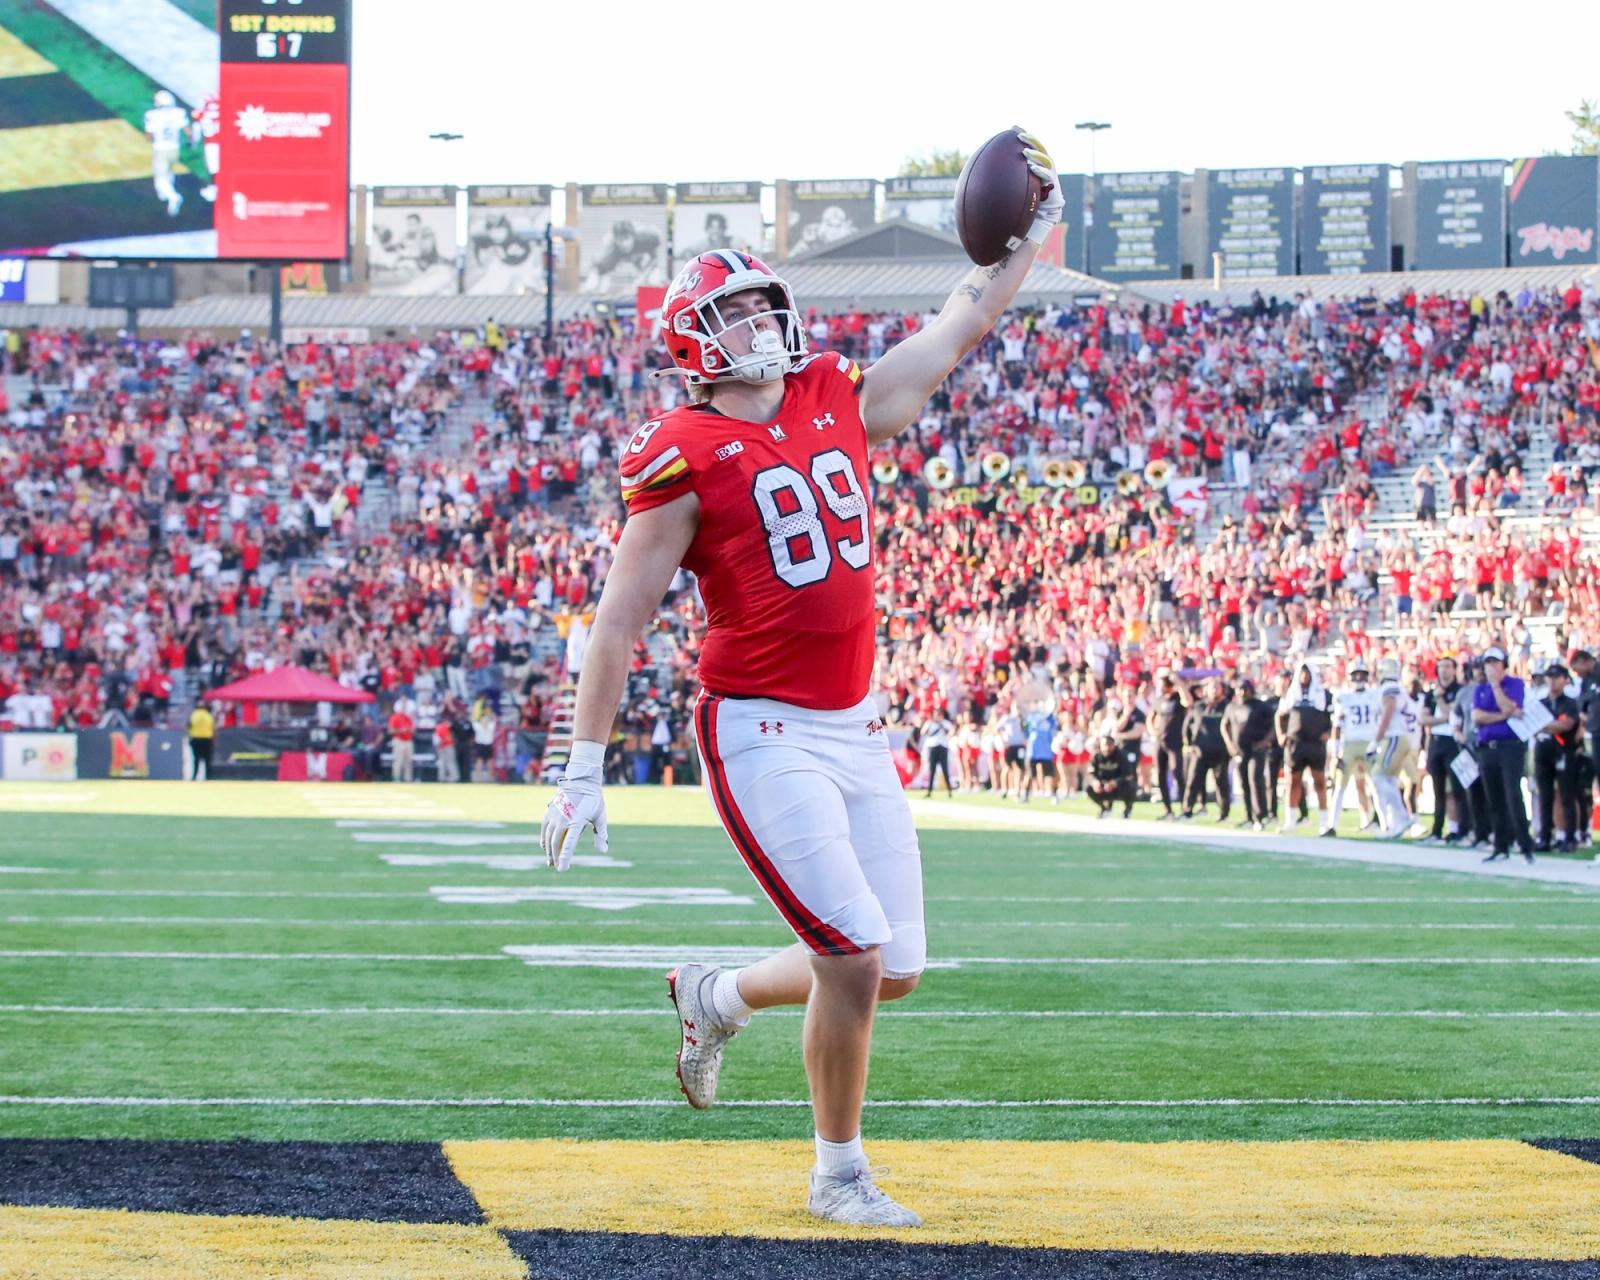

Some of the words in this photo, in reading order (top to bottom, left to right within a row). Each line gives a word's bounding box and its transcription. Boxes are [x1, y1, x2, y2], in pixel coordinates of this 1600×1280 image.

[230, 15, 264, 32] 1ST
[266, 15, 336, 33] DOWNS
[287, 32, 303, 57] 7
[767, 424, 788, 443] M
[752, 447, 871, 589] 89
[1349, 703, 1370, 725] 31
[110, 731, 149, 777] M
